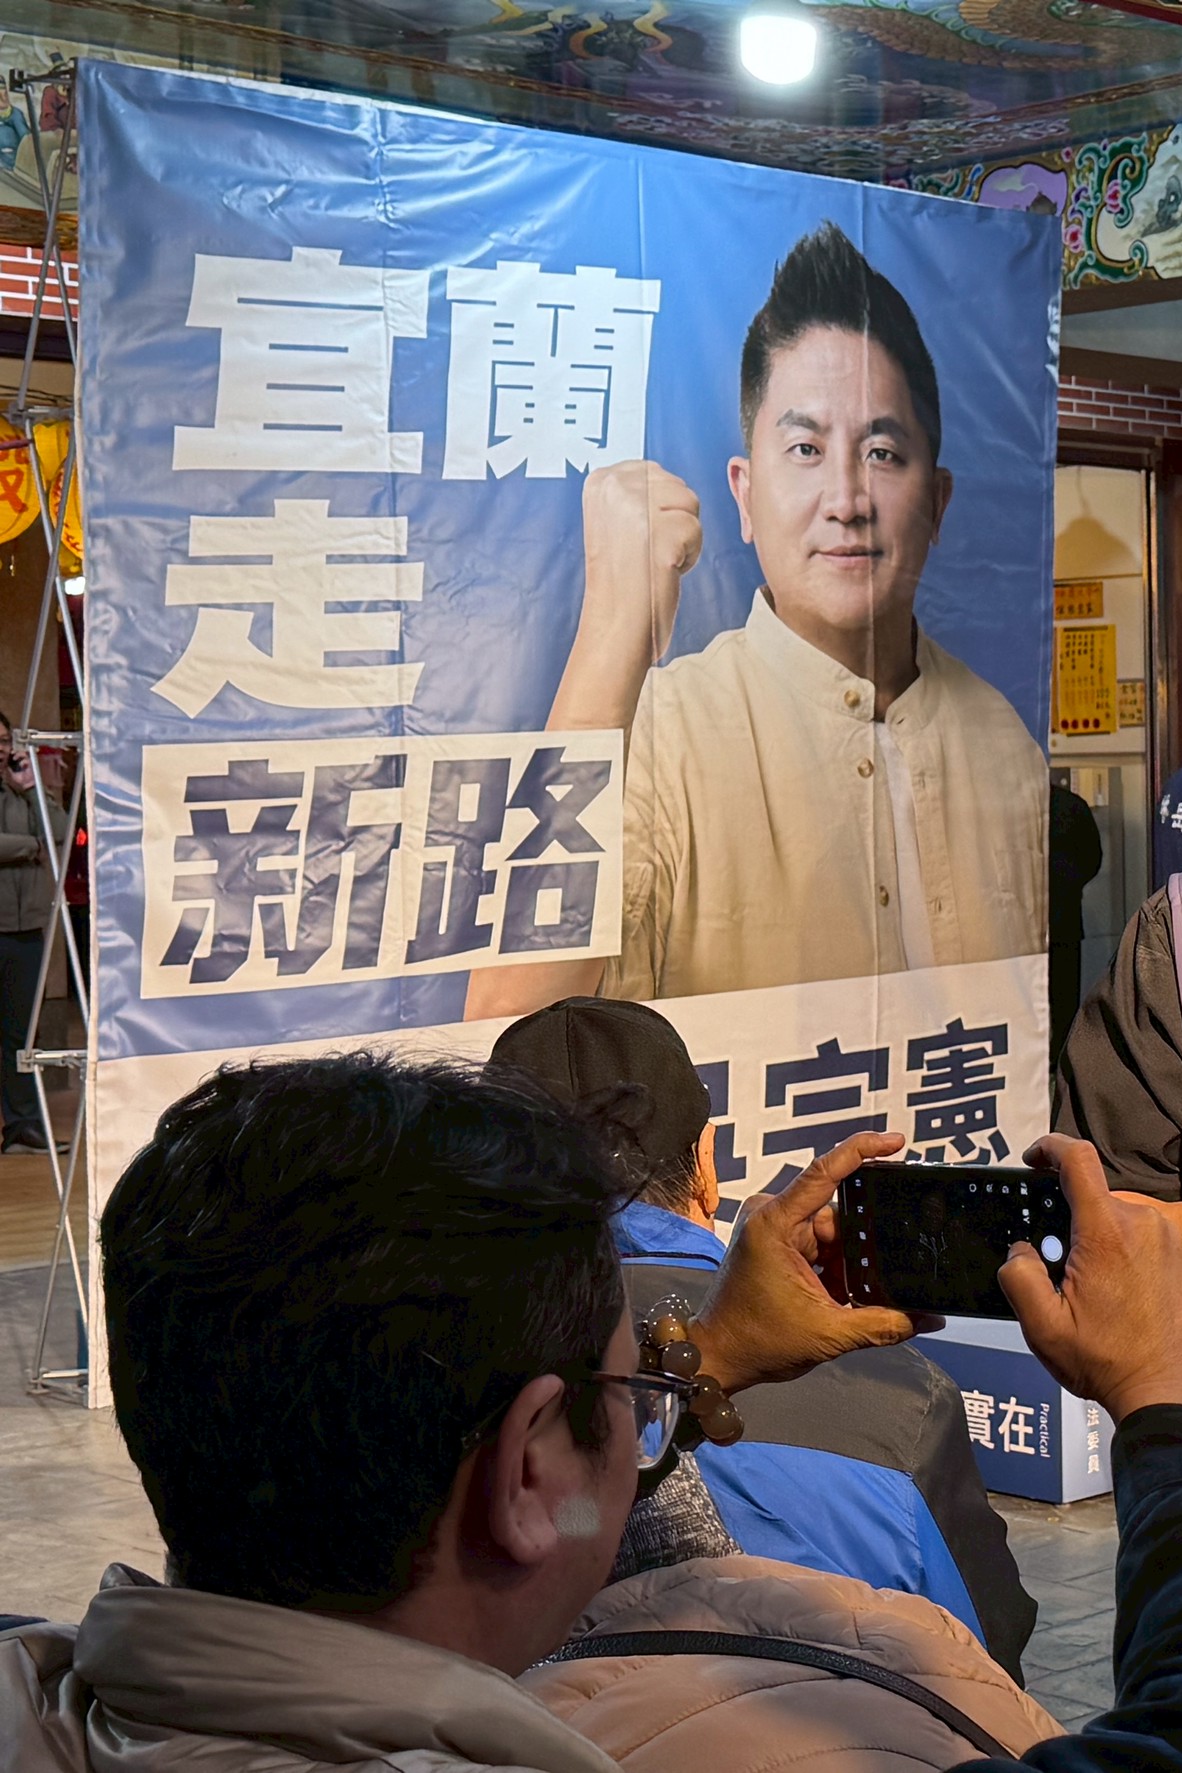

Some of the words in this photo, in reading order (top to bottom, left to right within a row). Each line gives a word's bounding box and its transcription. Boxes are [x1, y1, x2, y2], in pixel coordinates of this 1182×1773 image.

[172, 247, 661, 481] 宜蘭
[152, 498, 425, 718] 走
[160, 747, 613, 984] 新路
[960, 1389, 1036, 1456] 實在
[1039, 1403, 1051, 1458] Practical
